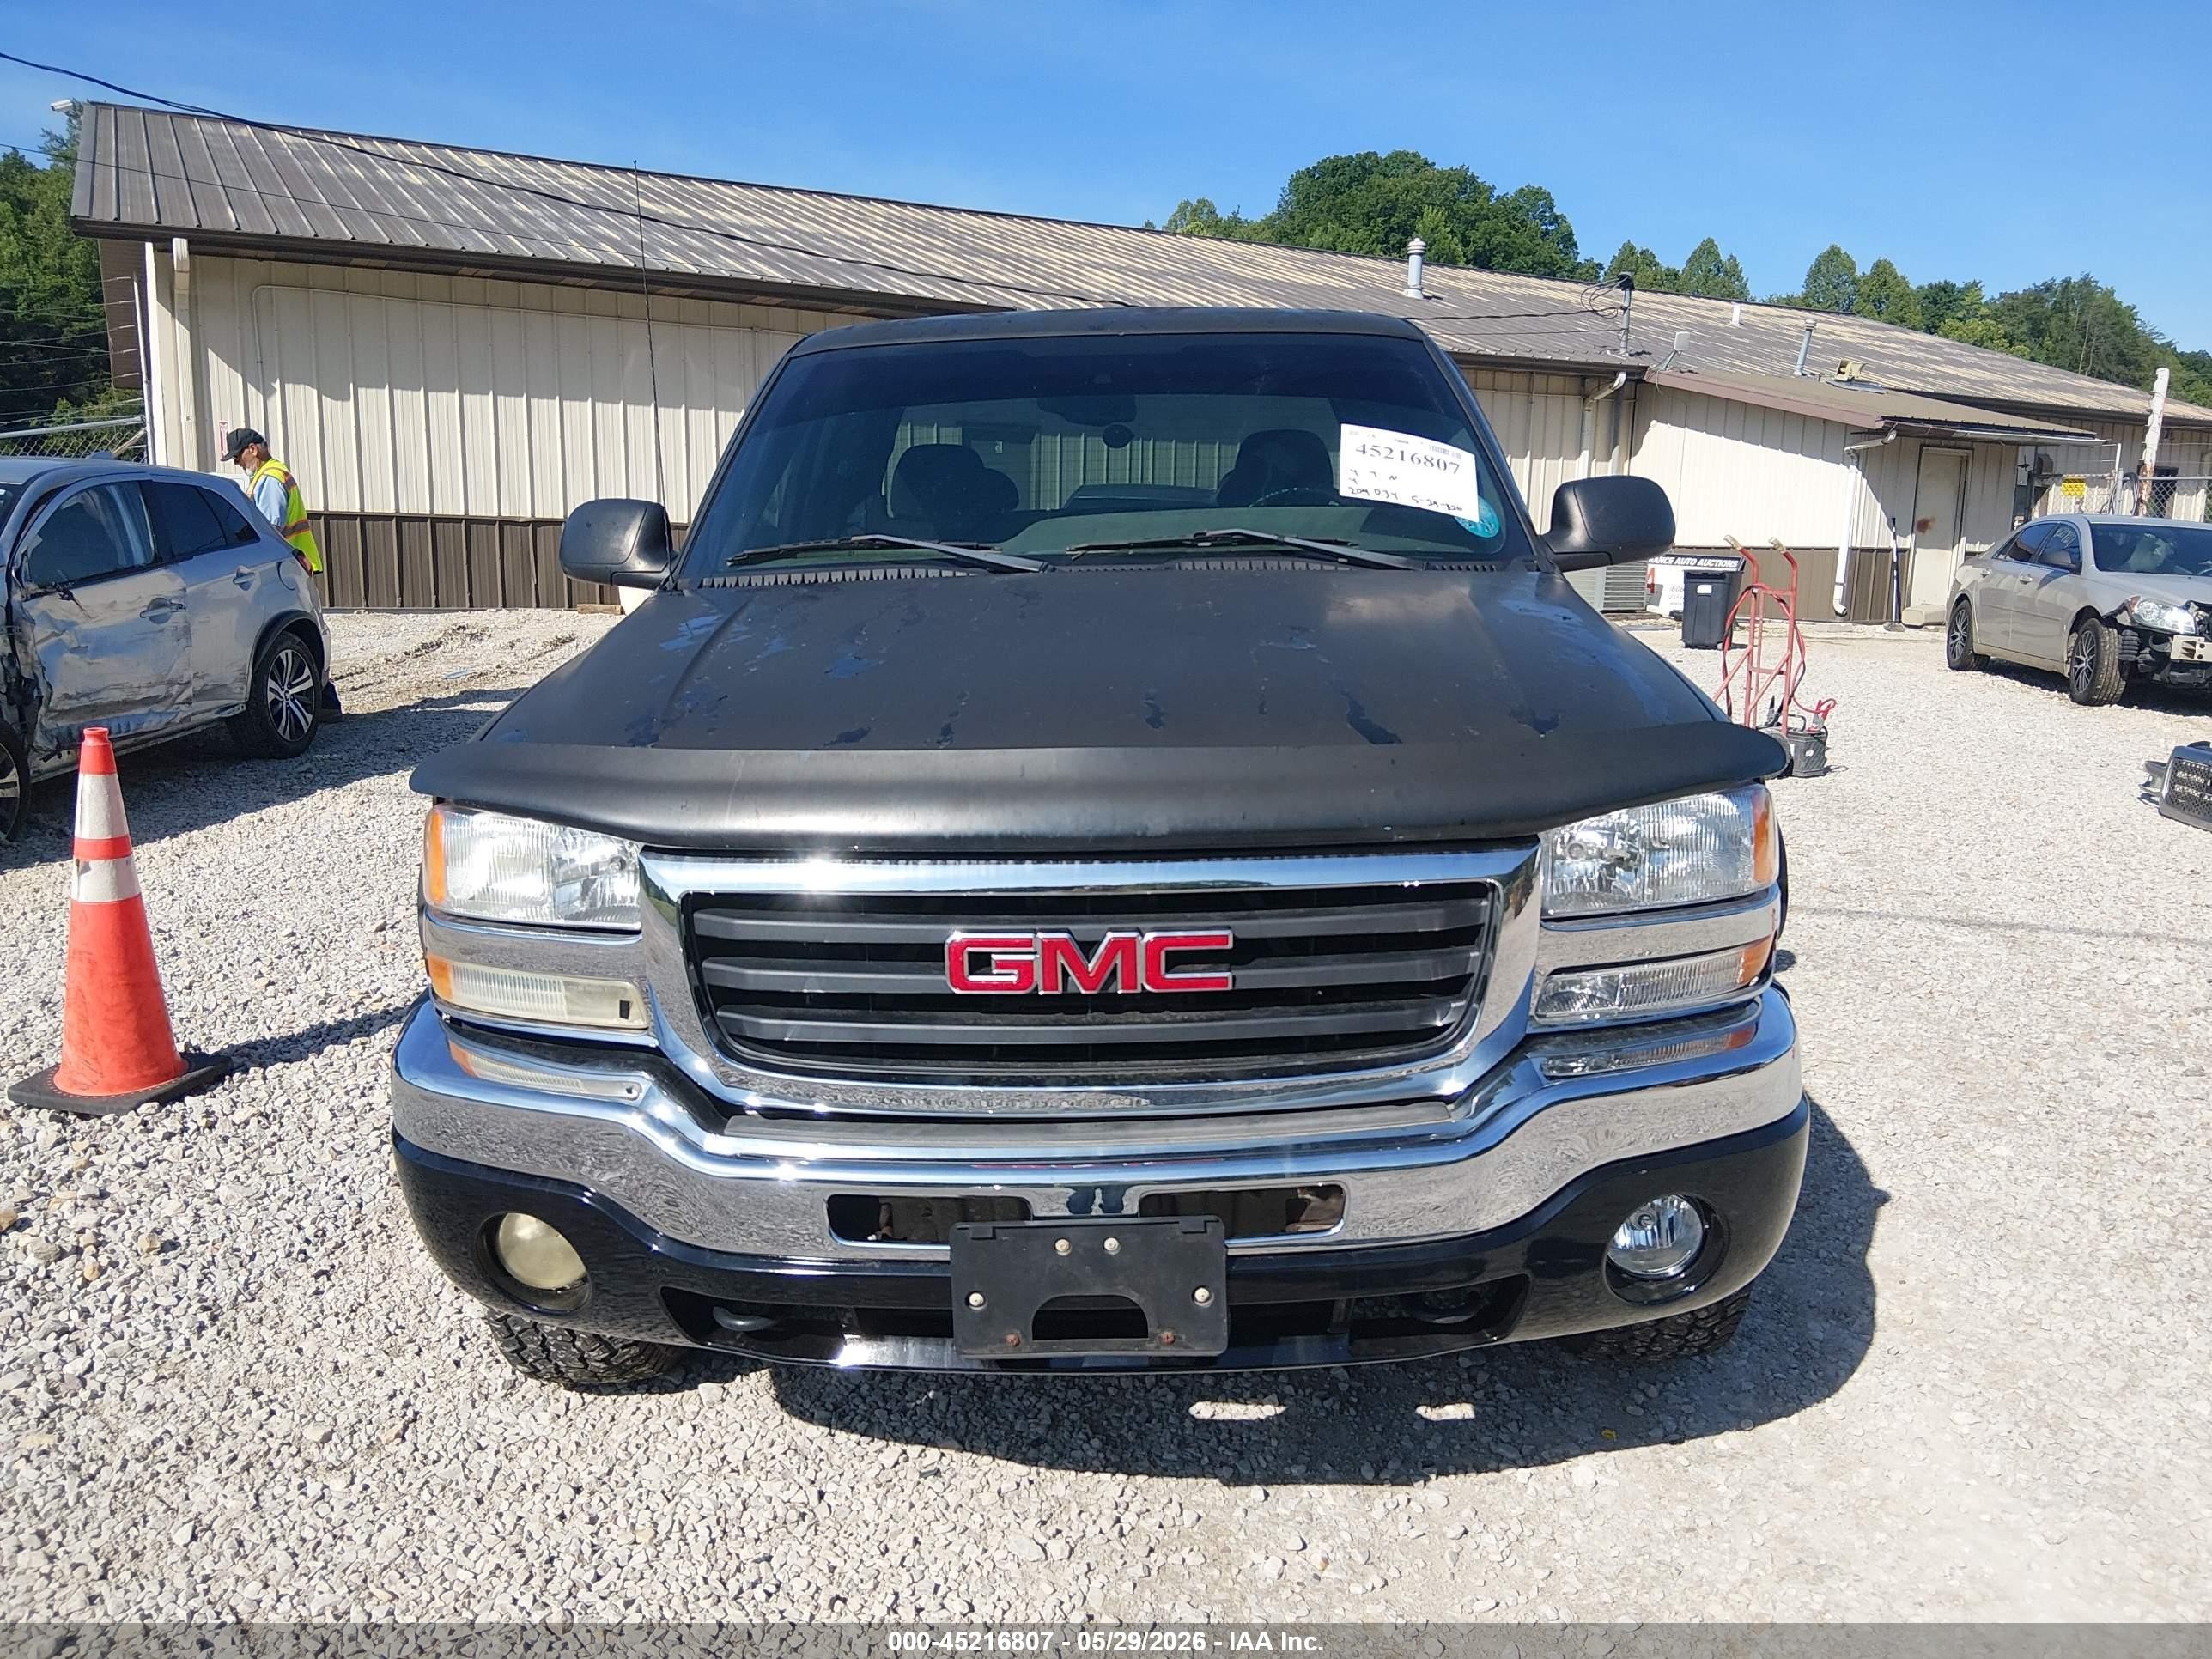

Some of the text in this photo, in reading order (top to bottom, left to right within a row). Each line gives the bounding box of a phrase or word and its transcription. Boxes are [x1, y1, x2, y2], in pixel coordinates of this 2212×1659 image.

[1355, 443, 1460, 474] 45216807
[1697, 559, 1739, 568] AUCTIONS
[944, 929, 1234, 994] GMC
